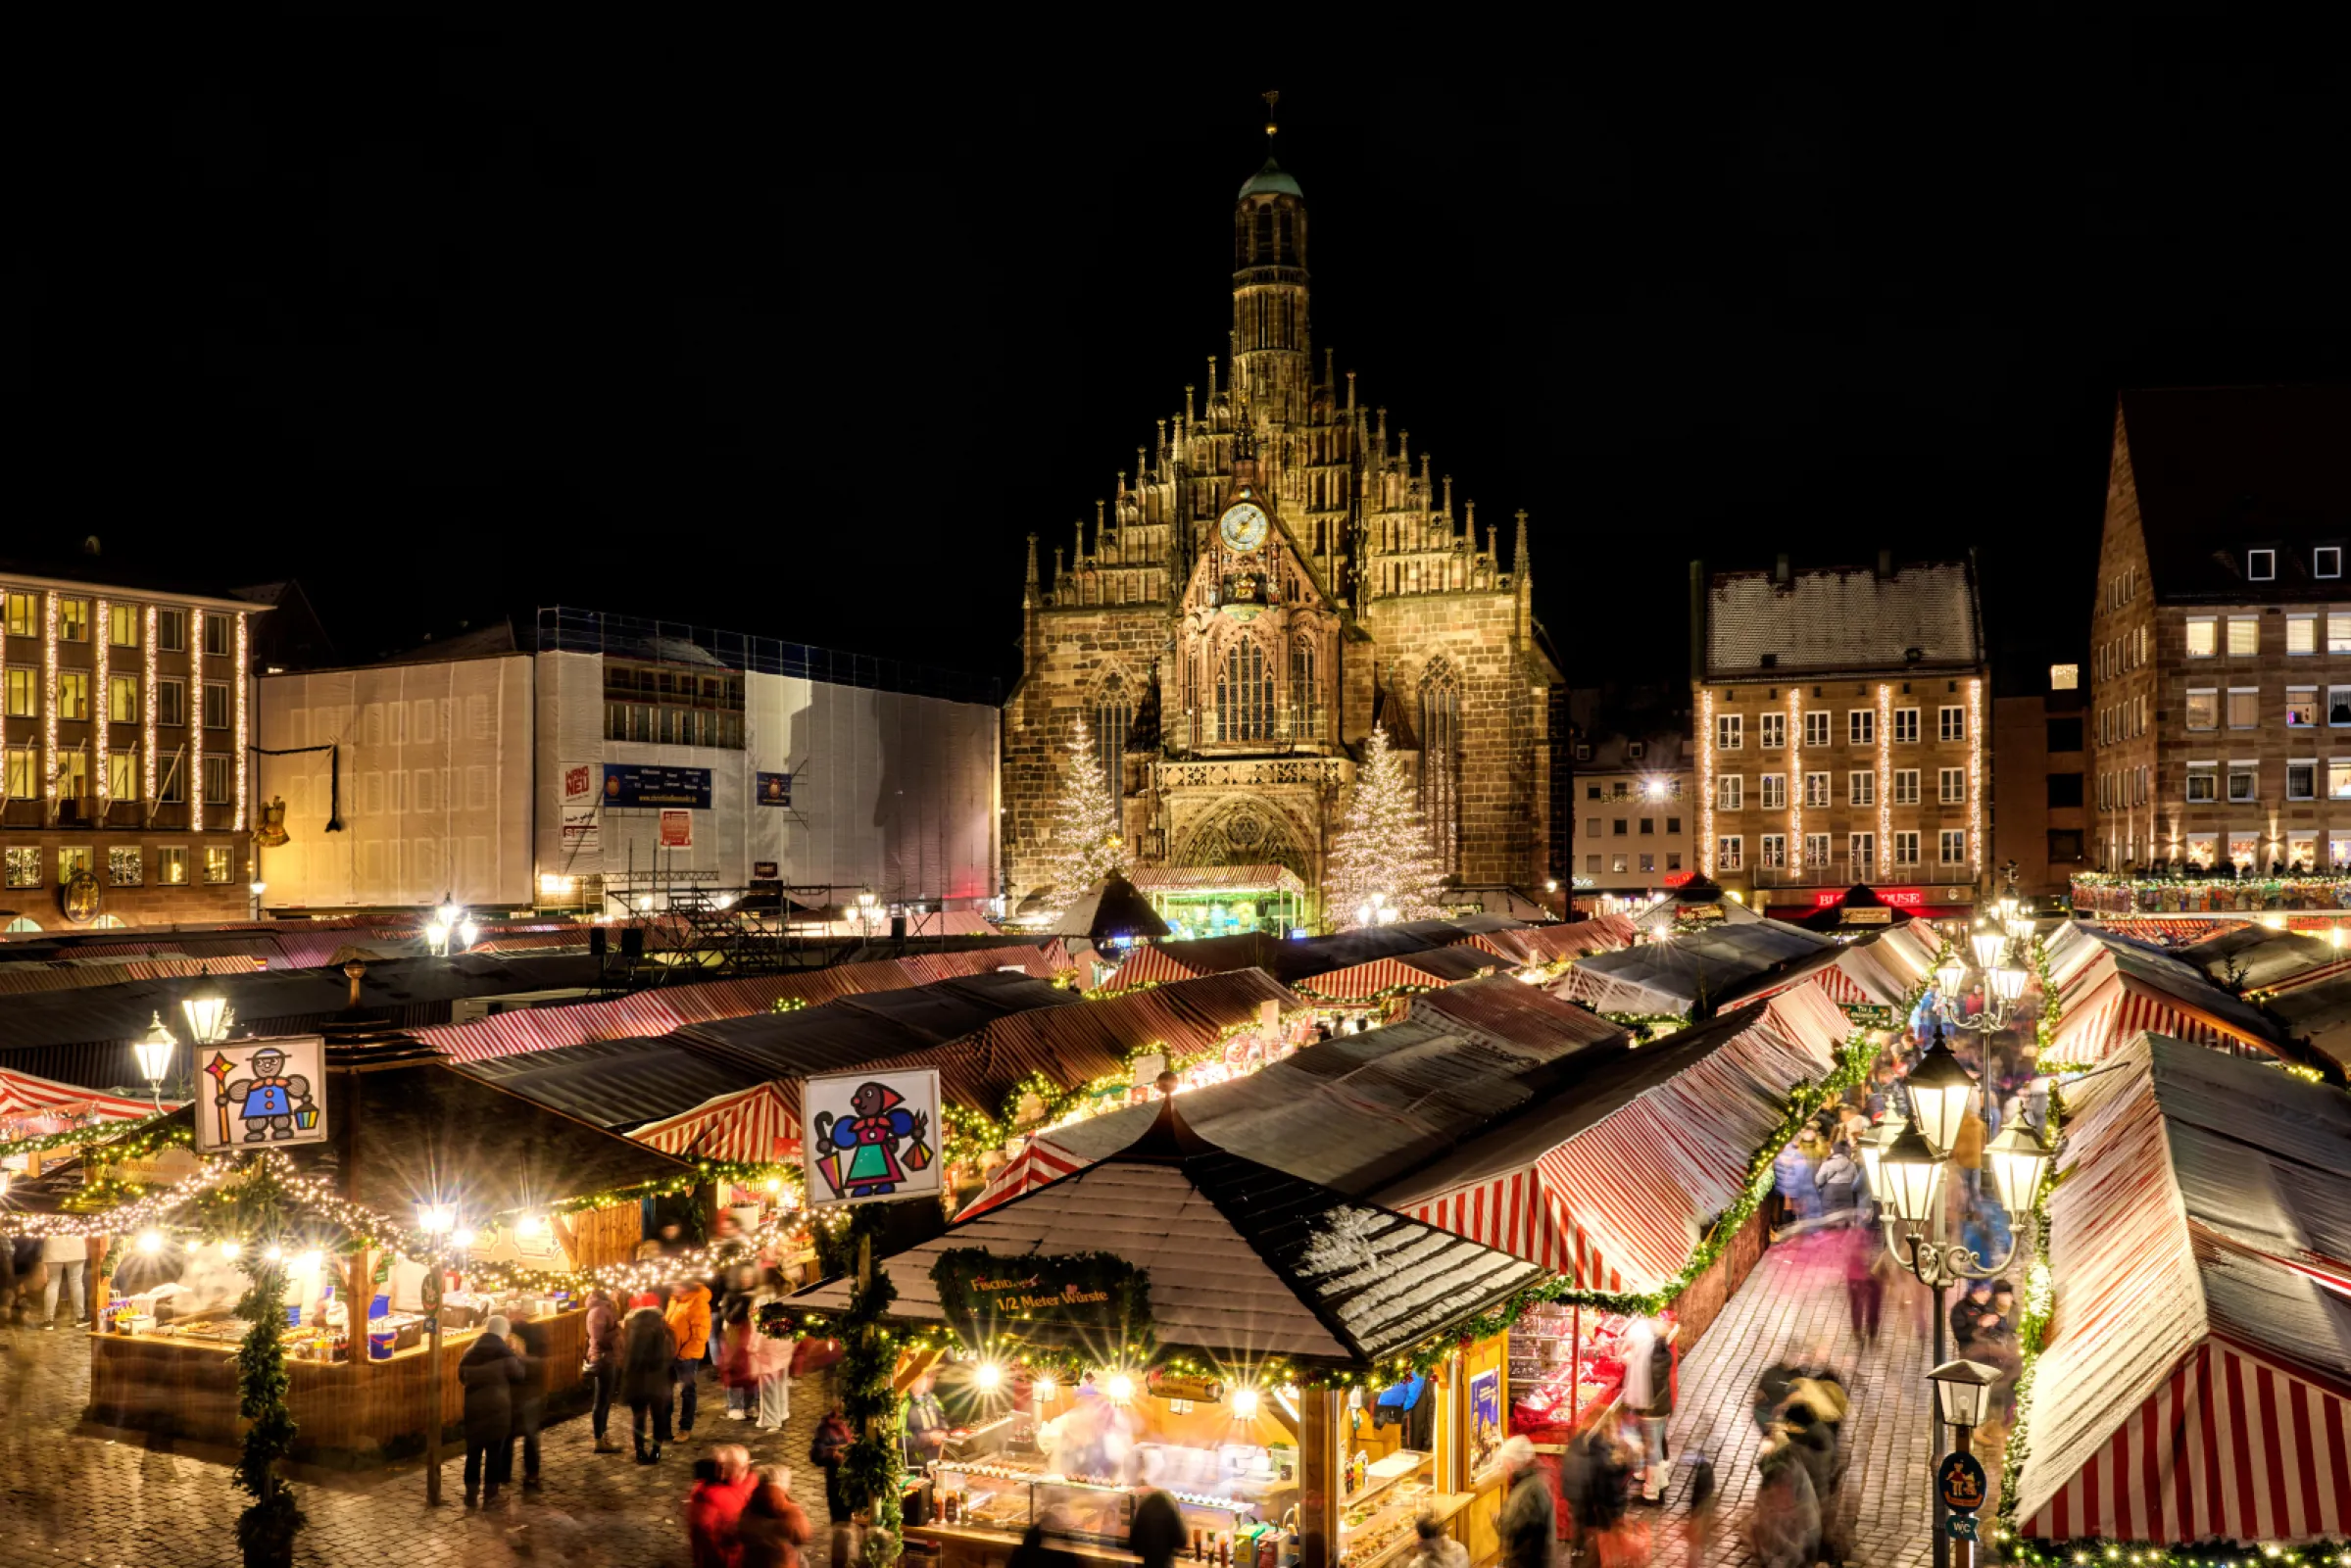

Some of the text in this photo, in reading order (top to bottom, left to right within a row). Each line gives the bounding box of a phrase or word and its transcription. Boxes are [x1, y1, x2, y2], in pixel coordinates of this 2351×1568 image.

[565, 777, 589, 797] NEU
[996, 1291, 1108, 1312] 1/2 Meter Würste
[1953, 1523, 1971, 1533] WC
